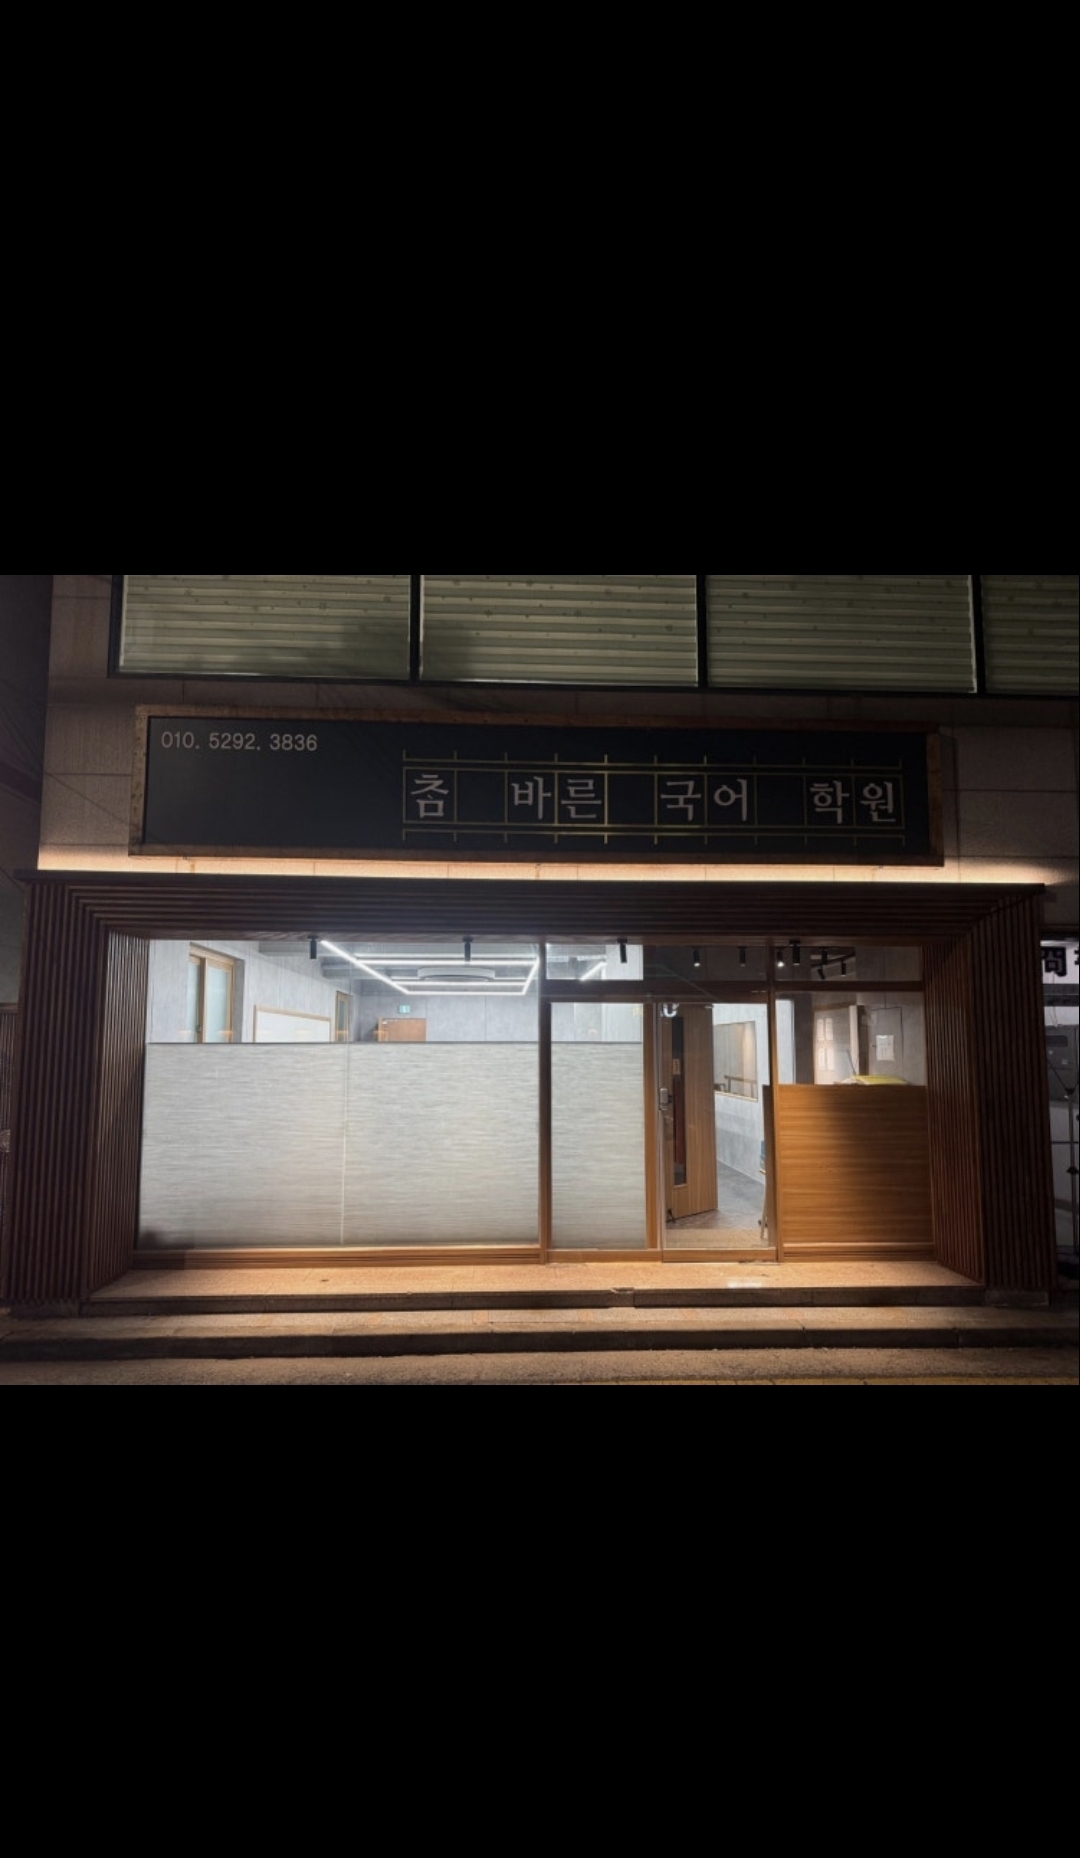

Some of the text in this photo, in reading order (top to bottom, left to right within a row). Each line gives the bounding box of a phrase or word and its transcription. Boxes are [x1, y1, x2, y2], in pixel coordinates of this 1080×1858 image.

[161, 731, 318, 752] 010. 5292. 3836
[511, 776, 603, 820] 바른
[660, 778, 749, 822] 국어
[809, 781, 897, 825] 학원
